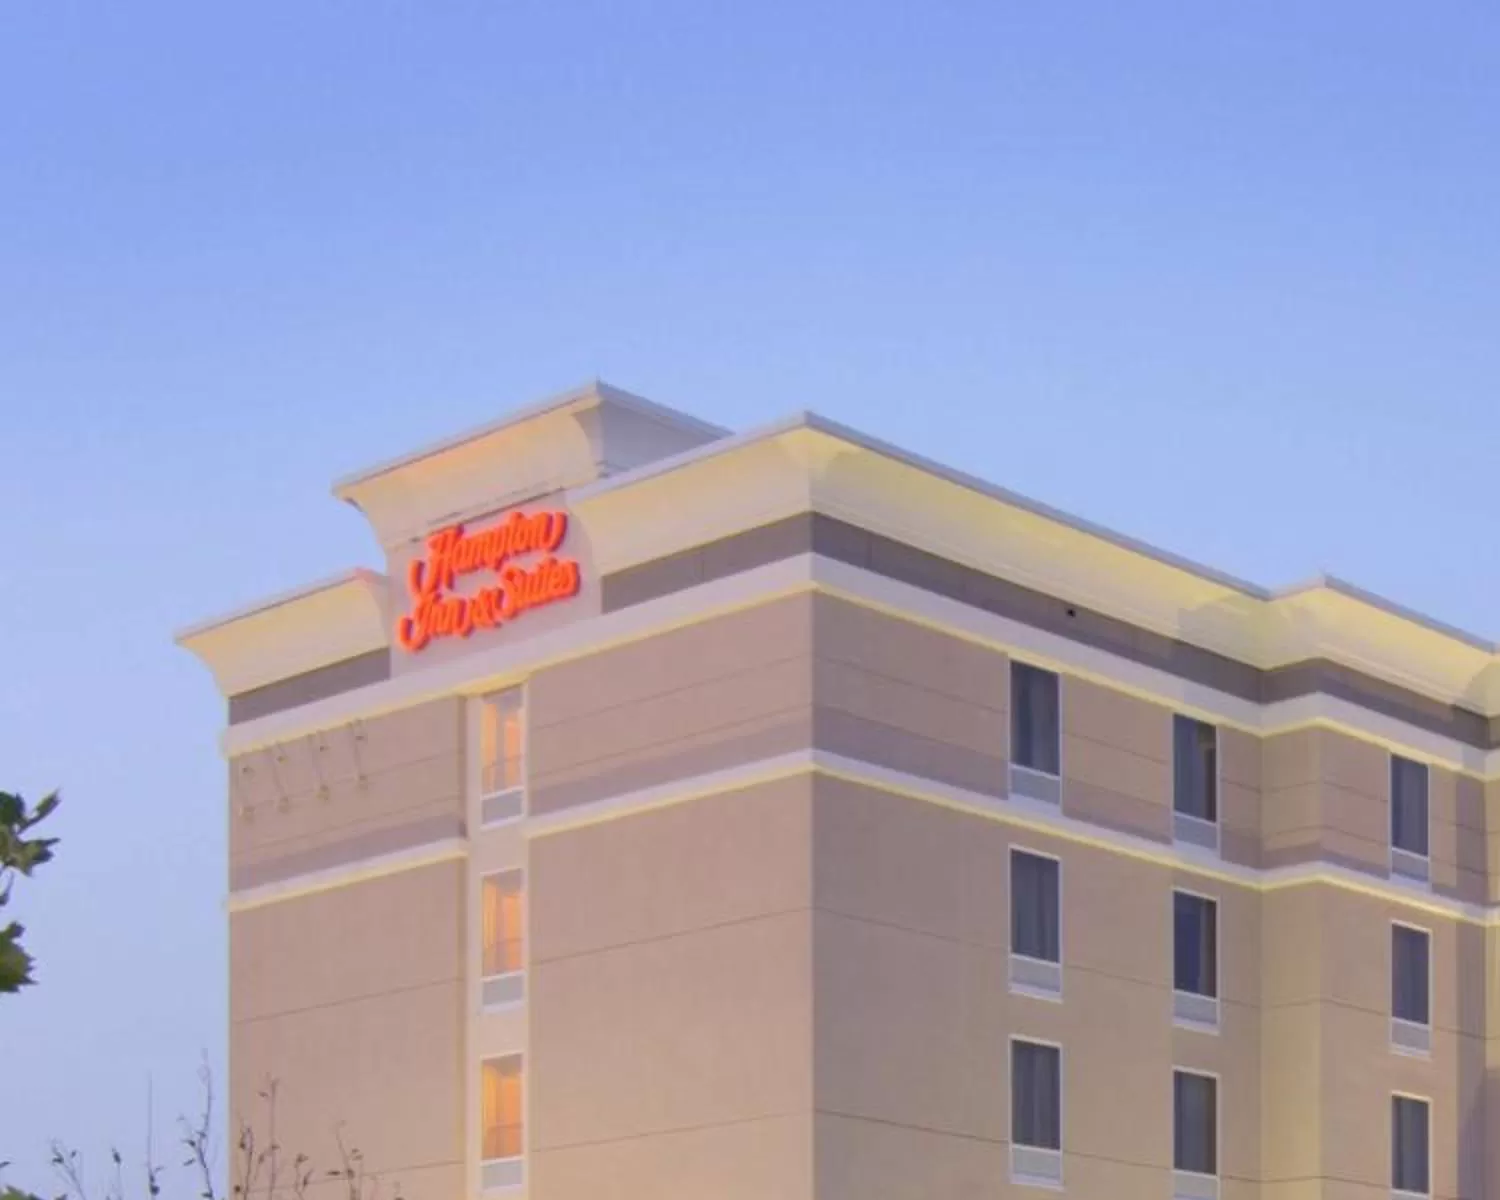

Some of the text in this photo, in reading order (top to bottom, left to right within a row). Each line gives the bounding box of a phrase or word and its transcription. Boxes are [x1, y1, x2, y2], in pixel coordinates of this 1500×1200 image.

[409, 511, 567, 595] Hampton
[397, 591, 474, 652] Inn
[502, 557, 580, 620] Suites
